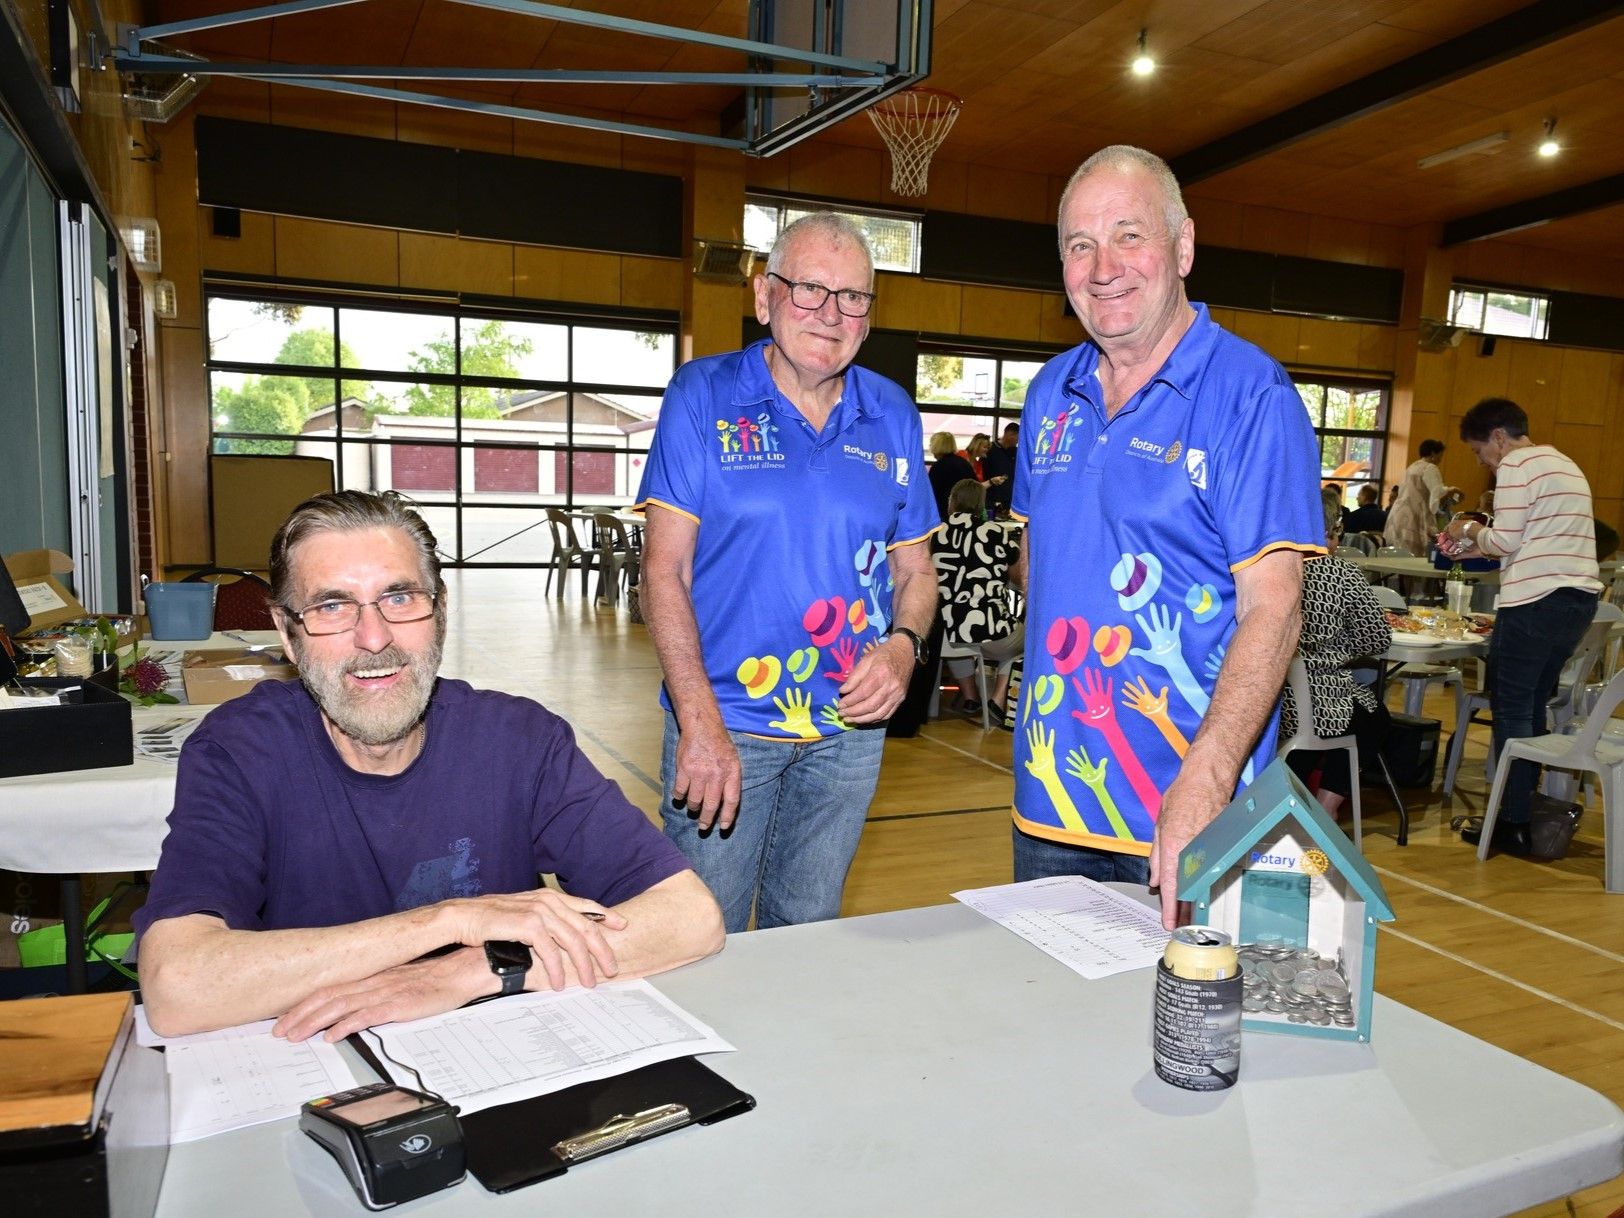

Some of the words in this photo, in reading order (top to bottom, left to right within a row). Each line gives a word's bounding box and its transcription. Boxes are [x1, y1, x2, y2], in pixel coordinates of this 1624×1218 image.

[843, 445, 873, 460] Rotary
[1130, 437, 1165, 456] Rotary
[720, 454, 744, 463] LIFT
[767, 453, 785, 461] LID
[1056, 454, 1072, 463] LID
[733, 462, 759, 471] mental
[1251, 852, 1296, 868] Rotary
